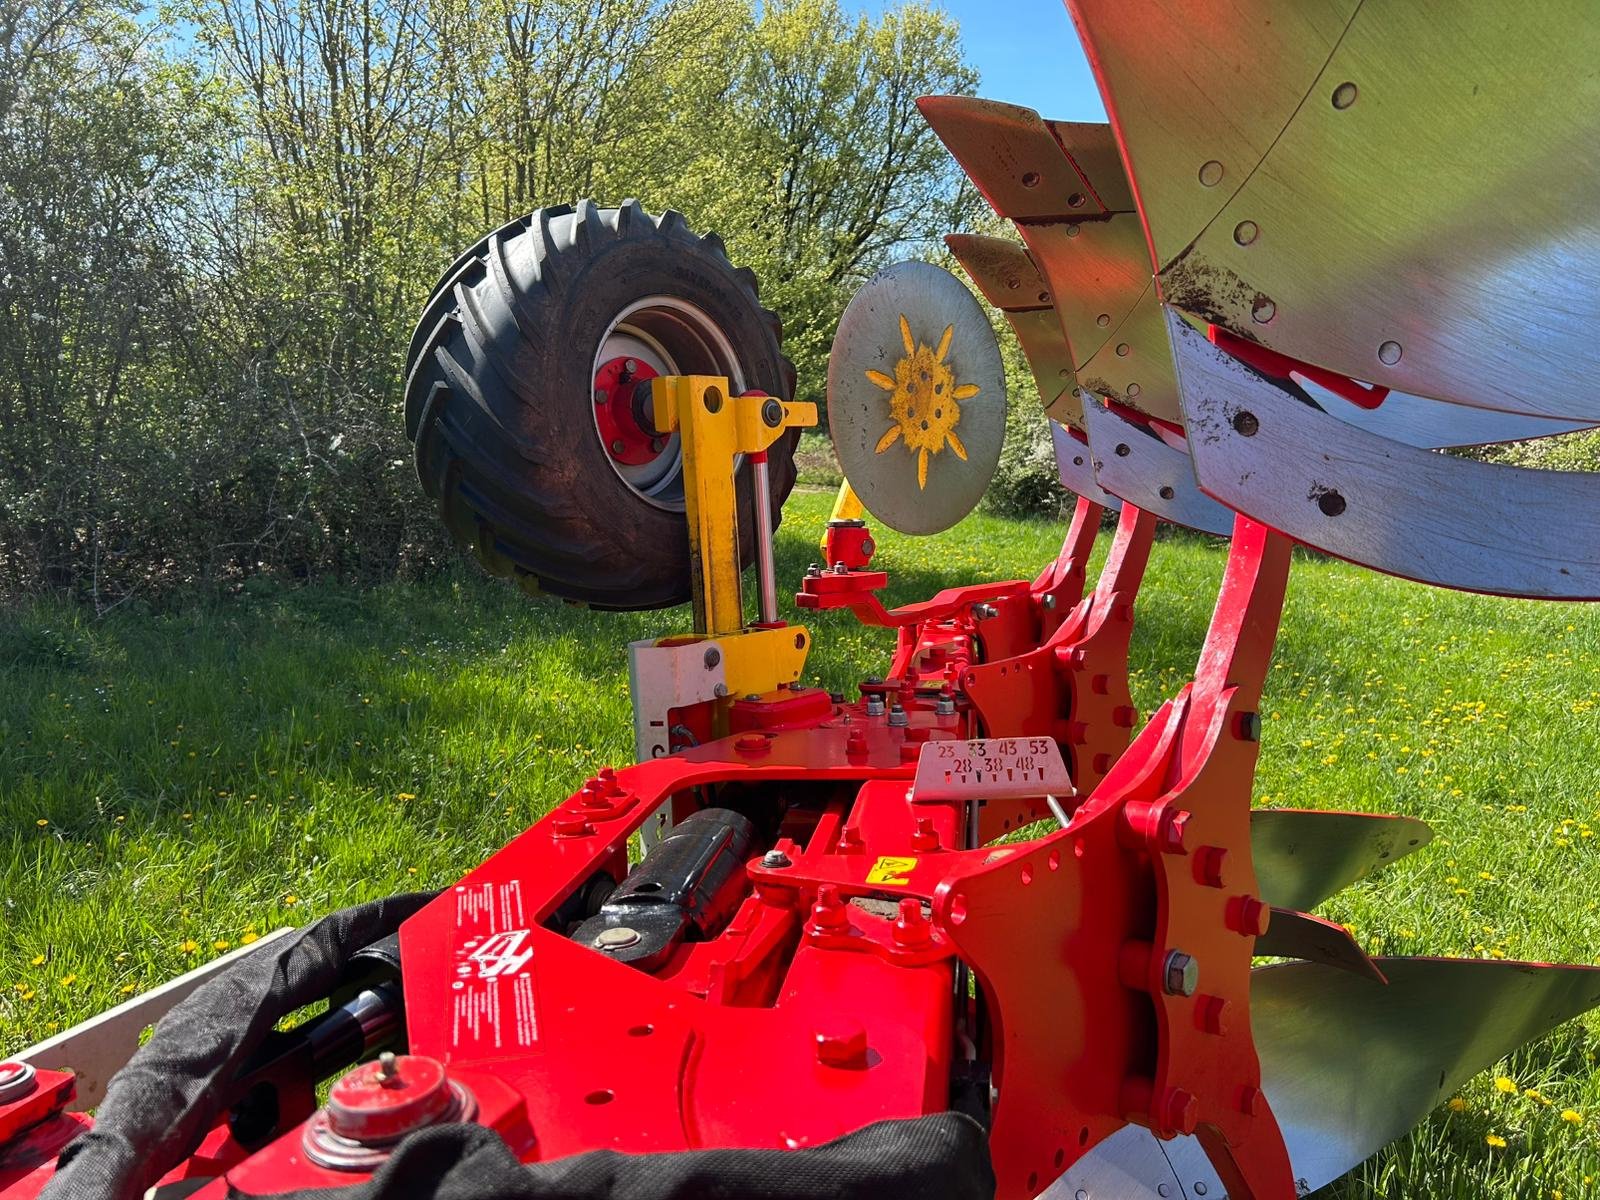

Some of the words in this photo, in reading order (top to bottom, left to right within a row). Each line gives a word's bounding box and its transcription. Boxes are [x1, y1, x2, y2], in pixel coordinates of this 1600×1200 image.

[938, 745, 955, 758] 23
[967, 742, 987, 757] 33
[998, 741, 1017, 756] 43
[1029, 740, 1048, 755] 53
[953, 758, 972, 773] 28
[984, 757, 1003, 772] 38
[1015, 756, 1034, 770] 48
